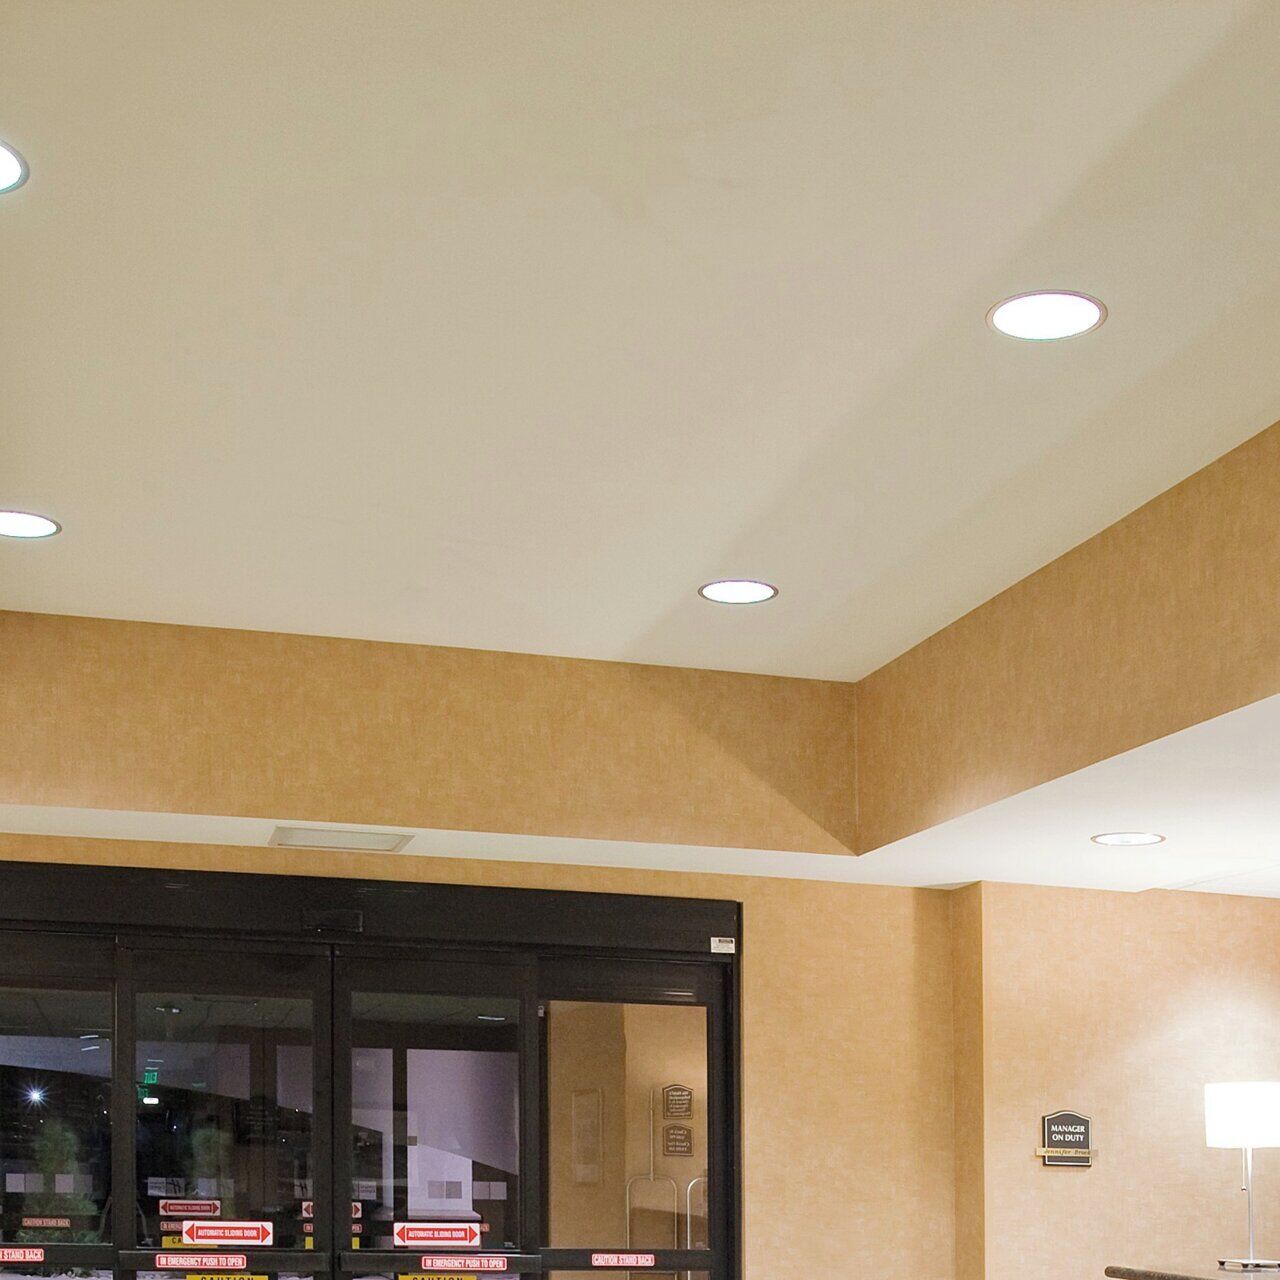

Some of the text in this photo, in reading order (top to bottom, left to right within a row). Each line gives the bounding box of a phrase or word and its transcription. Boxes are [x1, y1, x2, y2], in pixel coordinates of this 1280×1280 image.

[1050, 1124, 1085, 1133] MANAGER
[1052, 1133, 1084, 1142] ON DUTY
[225, 1229, 243, 1237] SLIDING
[244, 1229, 258, 1237] DOOR
[408, 1230, 433, 1238] AUTOMATIC
[452, 1230, 465, 1238] DOOR
[3, 1250, 24, 1260] STAND
[25, 1250, 42, 1260] BACK
[593, 1255, 652, 1264] CAUTION STAND BACK
[160, 1256, 243, 1266] IN EMERGENCY PUSH TO OPEN
[425, 1258, 504, 1268] IN EMERGENCY PUSH TO OPEN
